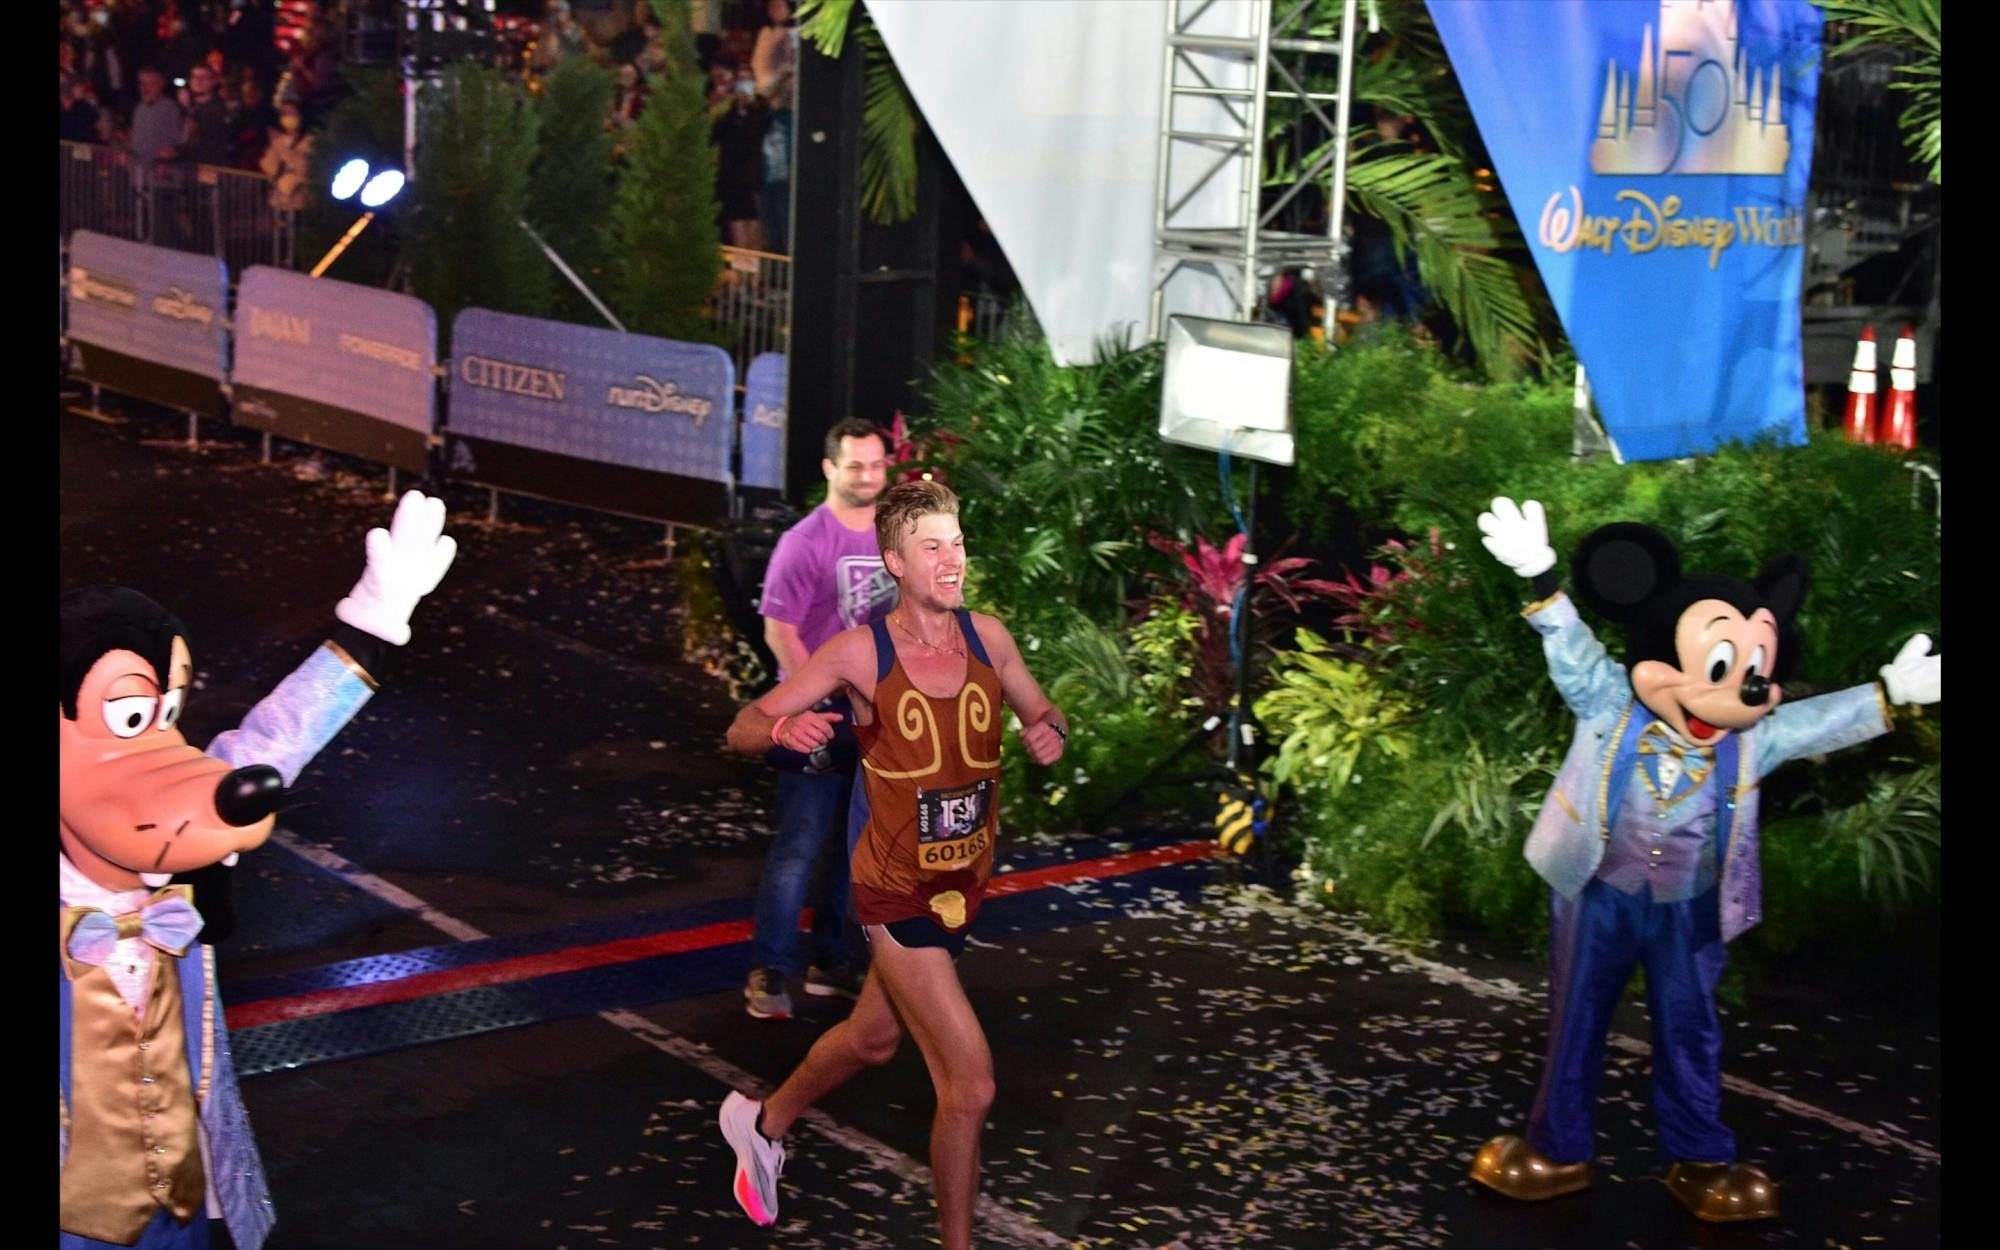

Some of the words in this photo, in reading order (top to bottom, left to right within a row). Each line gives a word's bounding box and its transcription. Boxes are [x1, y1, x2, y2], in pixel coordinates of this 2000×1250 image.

[1660, 49, 1730, 175] 50
[1539, 185, 1620, 254] Walt
[1616, 189, 1735, 269] Disney
[462, 355, 566, 400] CITIZEN
[919, 803, 929, 833] 60168
[924, 832, 986, 864] 60168
